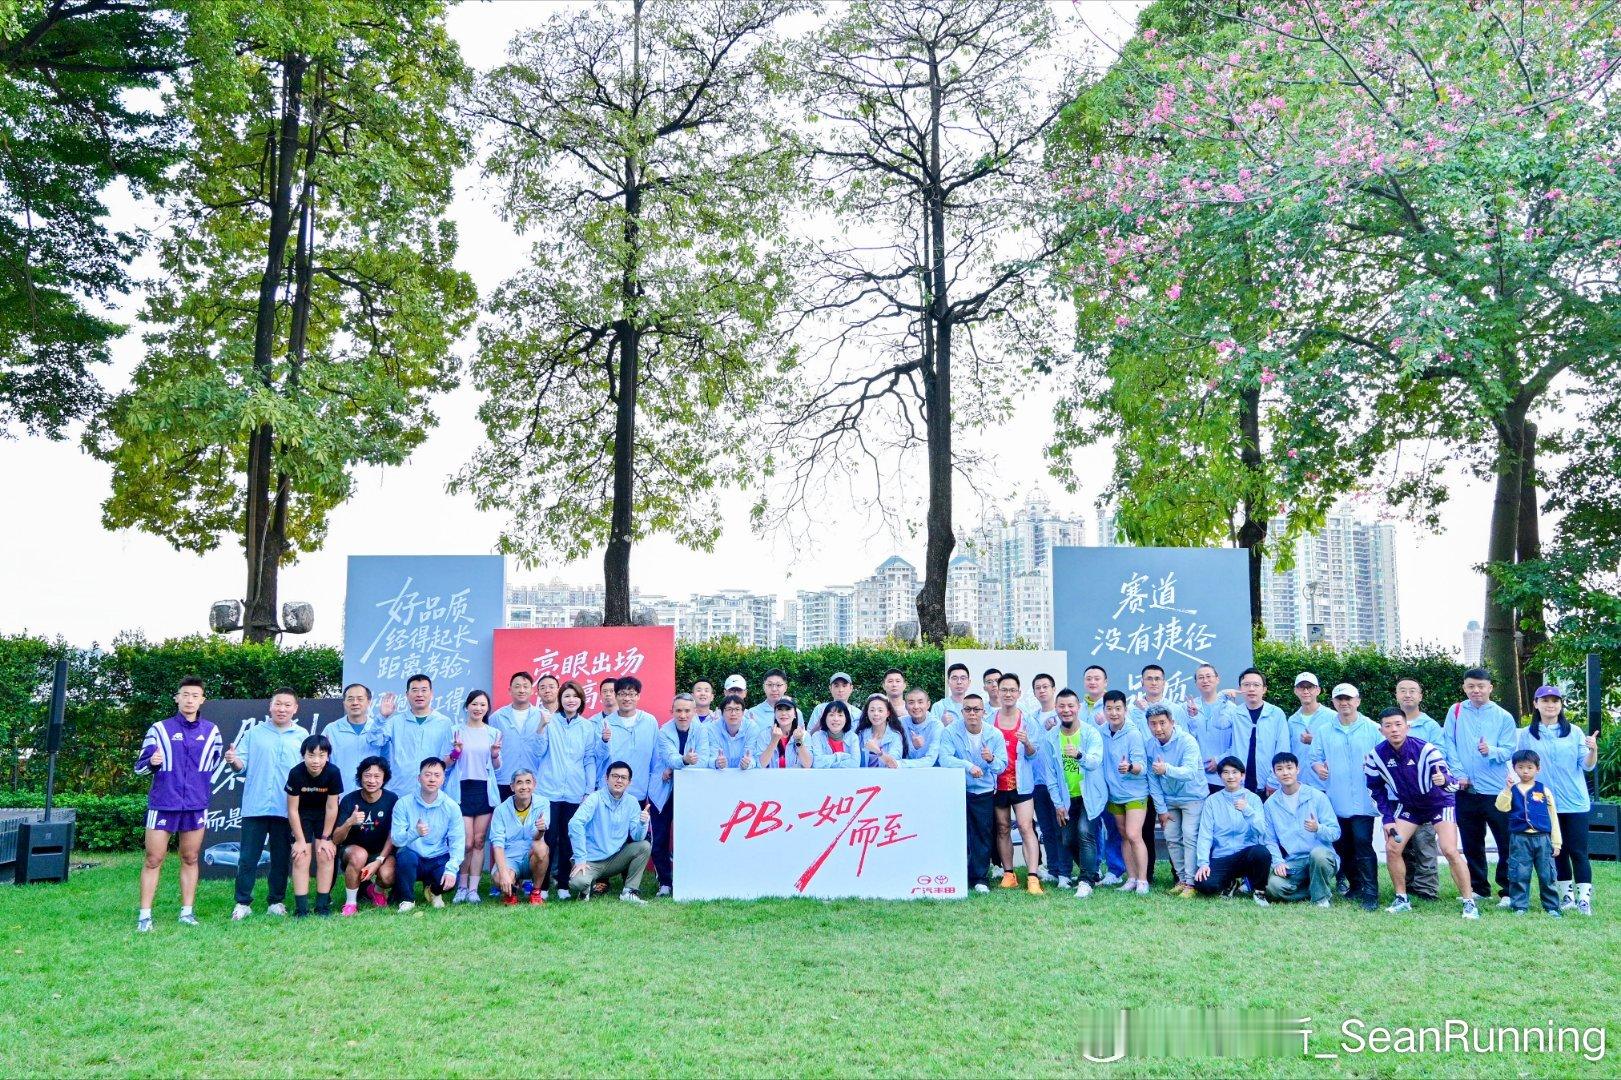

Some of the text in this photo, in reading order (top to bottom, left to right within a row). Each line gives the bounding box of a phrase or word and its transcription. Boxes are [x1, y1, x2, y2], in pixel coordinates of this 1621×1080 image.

[1112, 571, 1197, 620] 赛道
[360, 576, 476, 664] 好品质
[385, 624, 479, 653] 经得起长
[1090, 617, 1217, 665] 没有捷径
